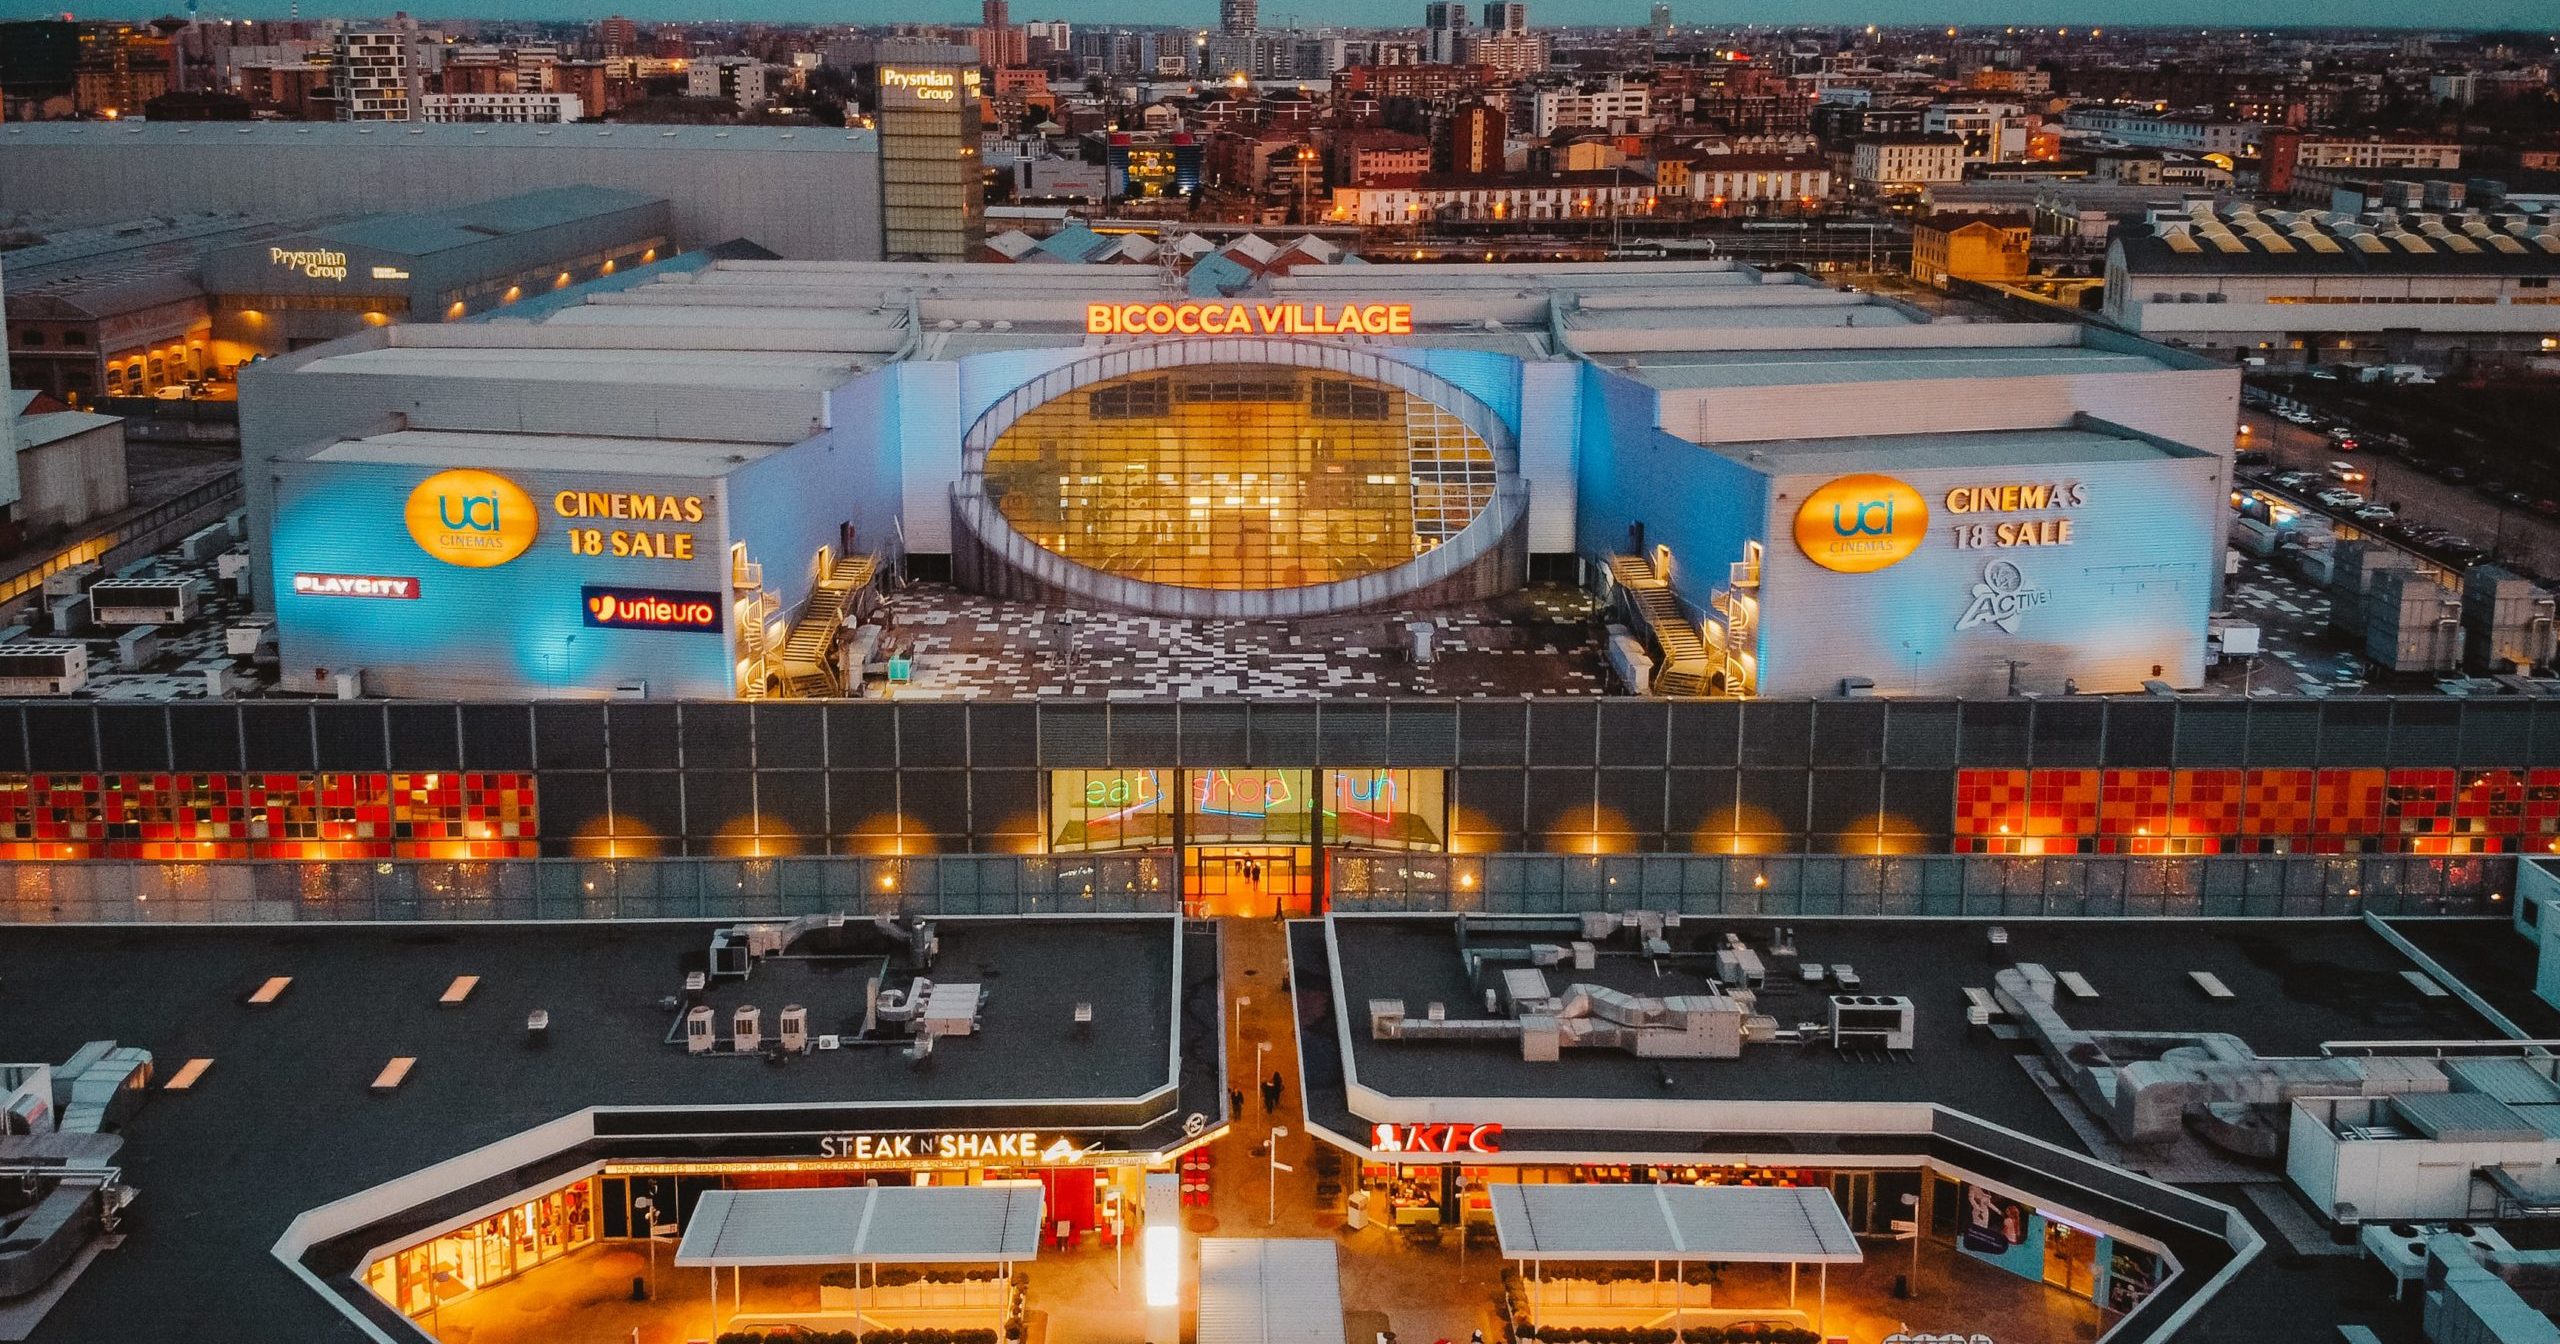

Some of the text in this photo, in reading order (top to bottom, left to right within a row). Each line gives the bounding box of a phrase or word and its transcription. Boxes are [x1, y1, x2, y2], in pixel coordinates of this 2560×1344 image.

[884, 69, 954, 90] Prysmian
[917, 87, 954, 103] Group
[270, 247, 347, 270] Prysmian
[305, 264, 347, 282] Group
[1087, 304, 1412, 334] BICOCCA VILLAGE
[439, 490, 501, 531] uci
[554, 490, 704, 523] CINEMAS
[1946, 483, 2088, 514] CINEMAS
[1833, 493, 1894, 537] uci
[440, 534, 503, 549] CINEMAS
[568, 529, 694, 560] 18 SALE
[1829, 539, 1894, 553] CINEMAS
[1955, 520, 2075, 549] 18 SALE
[296, 576, 408, 600] PLAYCITY
[619, 597, 714, 623] unieuro
[1086, 771, 1149, 804] eat
[1193, 770, 1287, 808] shop
[820, 1134, 912, 1159] STEAK
[940, 1133, 1037, 1158] SHAKE
[1402, 1122, 1503, 1152] KFC
